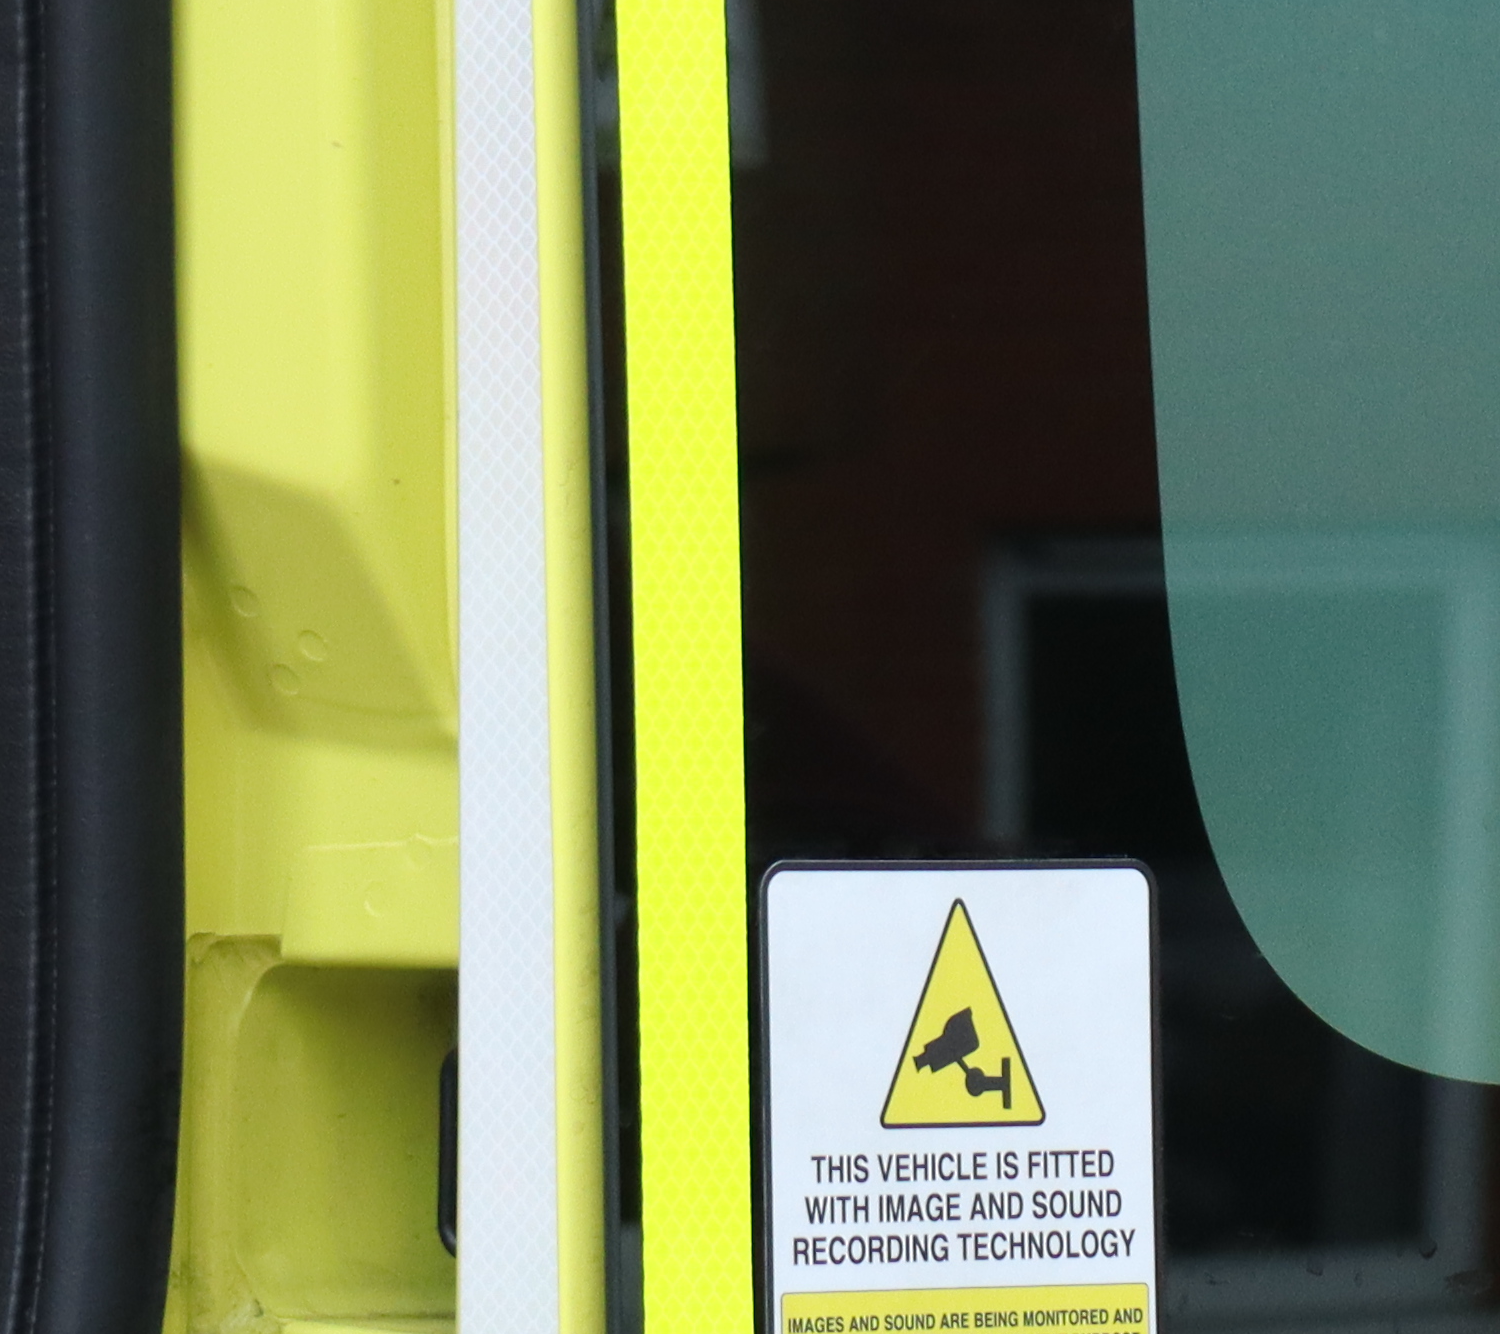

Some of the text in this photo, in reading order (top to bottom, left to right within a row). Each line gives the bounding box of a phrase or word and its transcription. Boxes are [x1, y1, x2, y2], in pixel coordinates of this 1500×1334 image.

[810, 1149, 1115, 1184] THIS VEHICLE IS FITTED
[804, 1189, 1122, 1225] WITH IMAGE AND SOUND
[793, 1228, 1136, 1266] RECORDING TECHNOLOGY
[787, 1307, 1144, 1334] IMAGES AND SOUND ARE BEING MONITORED AND
